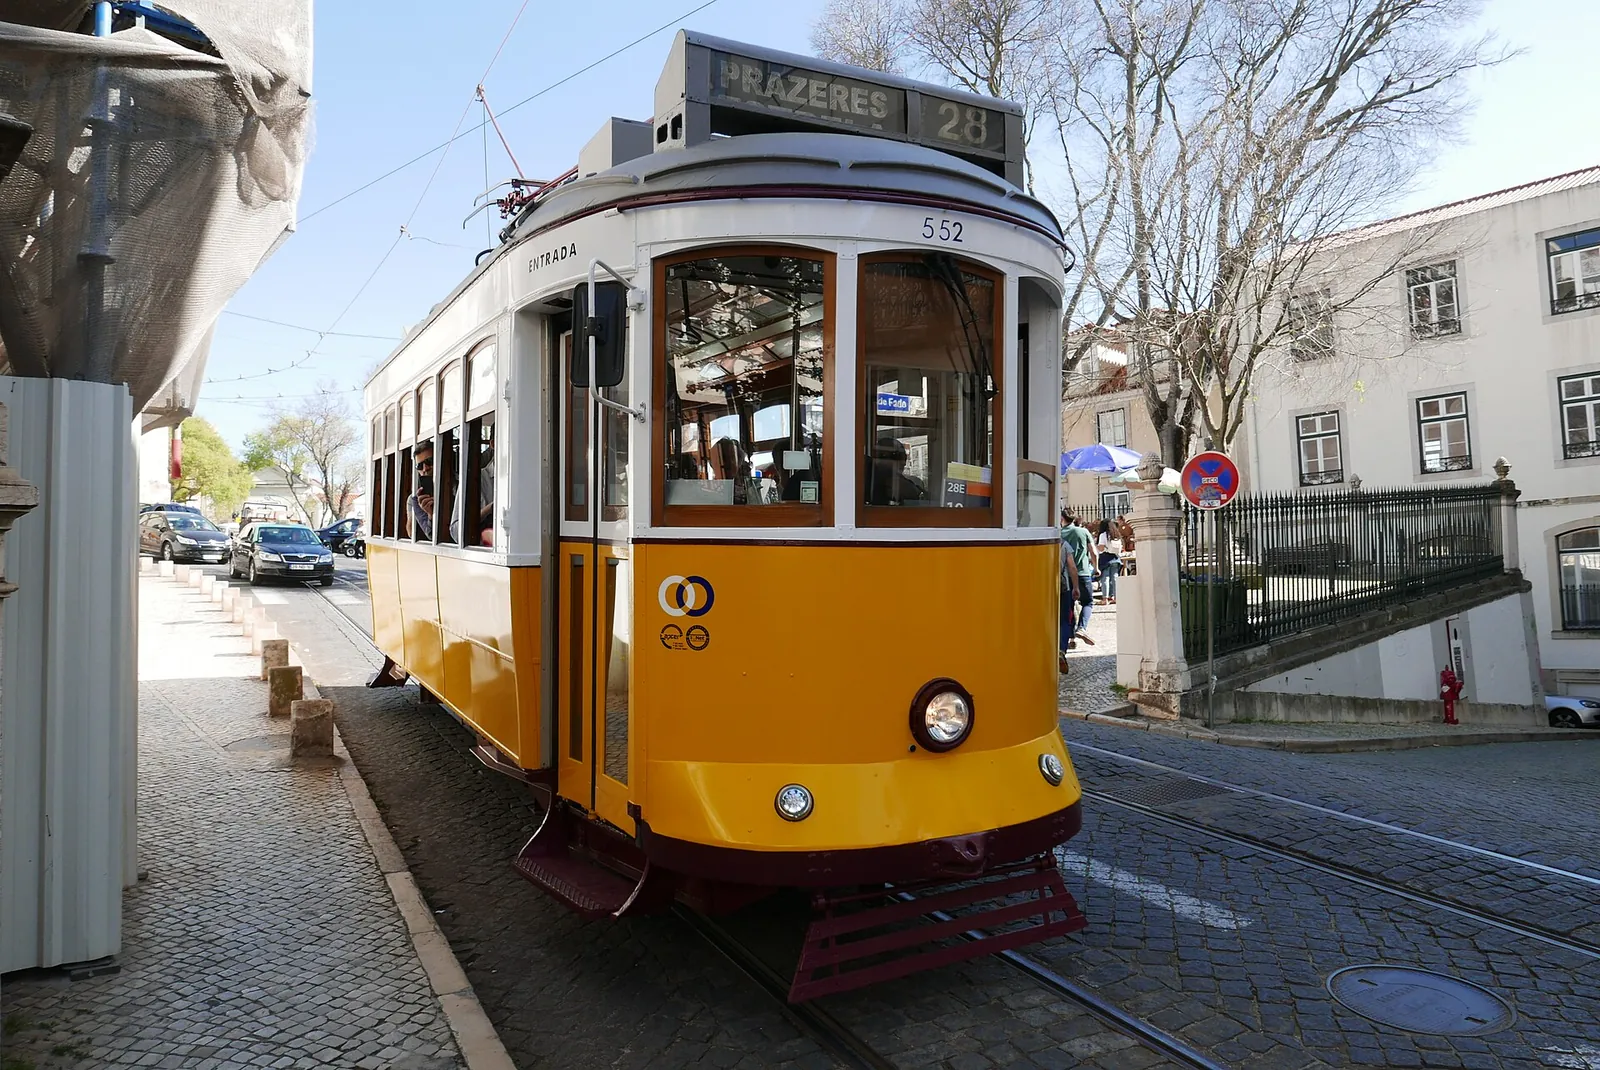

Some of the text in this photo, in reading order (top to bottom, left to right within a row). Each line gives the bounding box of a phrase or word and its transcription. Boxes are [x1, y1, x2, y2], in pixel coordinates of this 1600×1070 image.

[719, 58, 889, 120] PRAZERES
[937, 100, 988, 145] 28
[921, 216, 964, 244] 552
[528, 242, 577, 273] ENTRADA
[888, 397, 907, 409] Fado
[947, 482, 965, 494] 28E
